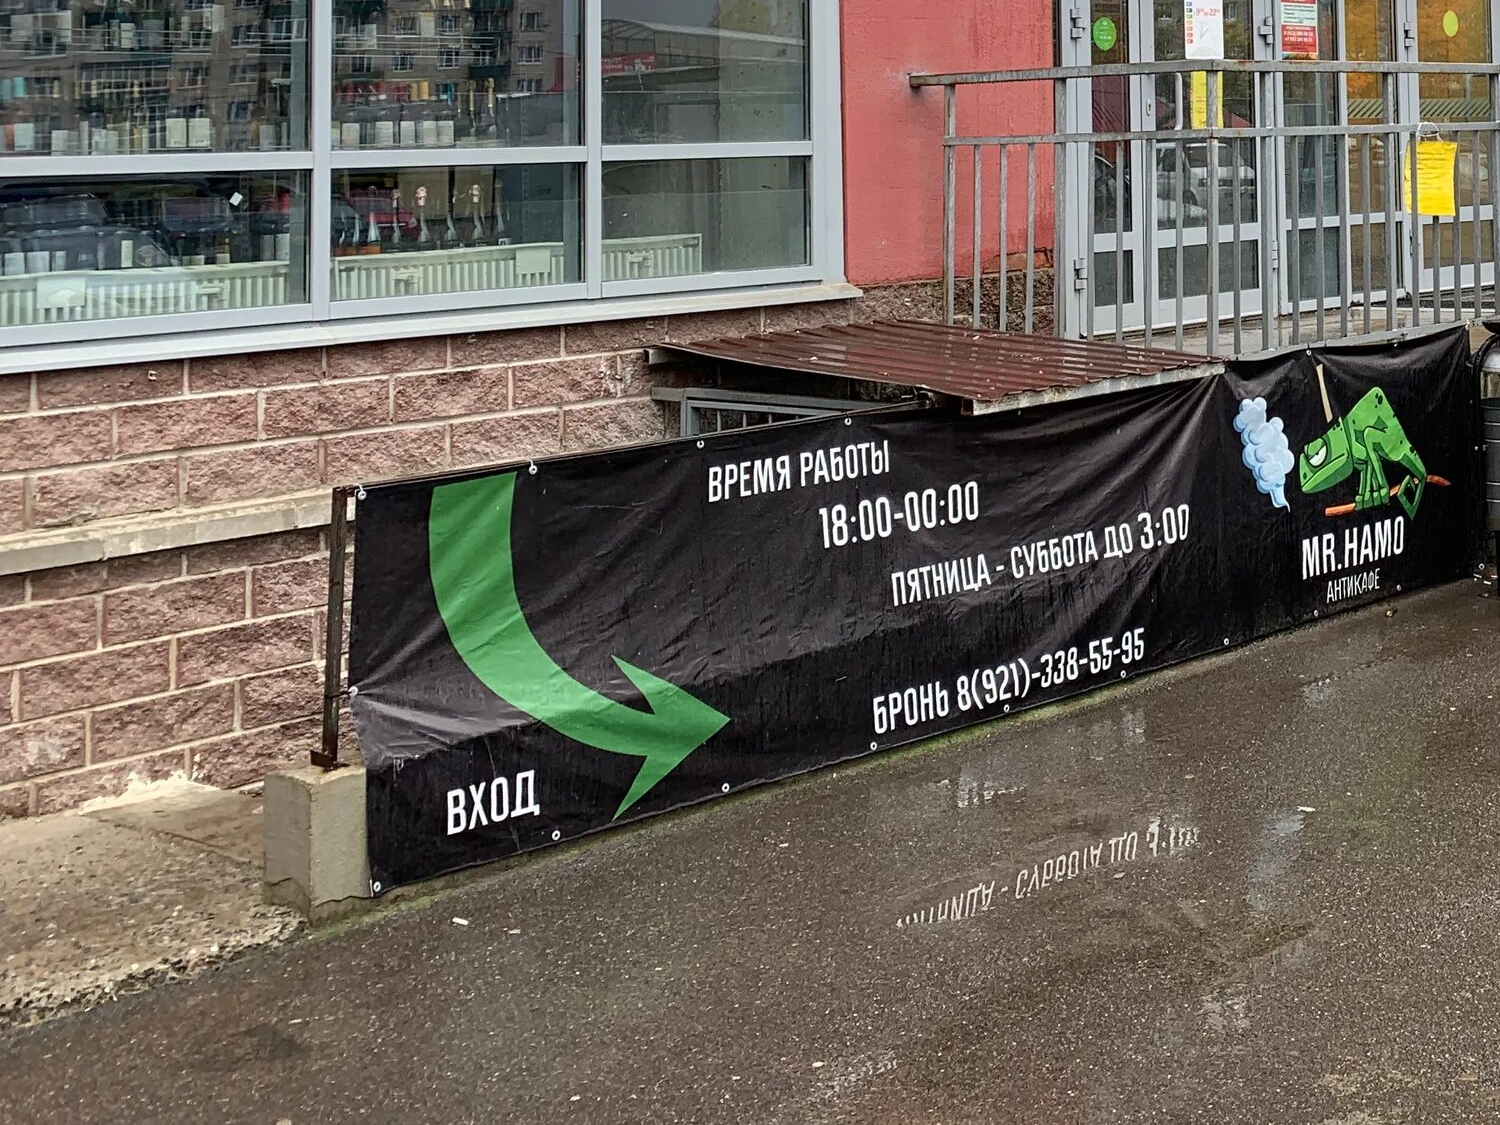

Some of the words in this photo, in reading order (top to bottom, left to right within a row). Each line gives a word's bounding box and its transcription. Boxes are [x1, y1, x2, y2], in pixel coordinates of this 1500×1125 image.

[708, 454, 792, 503] ВРЕМЯ
[799, 439, 890, 487] РАБОТЫ
[818, 480, 980, 549] 18:00-00:00
[1302, 515, 1405, 580] MR.HAMO
[890, 553, 992, 607] ПЯТНИЦА
[1010, 530, 1099, 579] СУББОТА
[1103, 522, 1134, 559] ДО
[1137, 504, 1190, 550] 3:00
[1326, 567, 1381, 604] АНТИКАФЕ
[872, 680, 949, 734] БРОНЬ
[956, 626, 1146, 712] 8(921)-338-55-95
[446, 769, 541, 836] ВХОД
